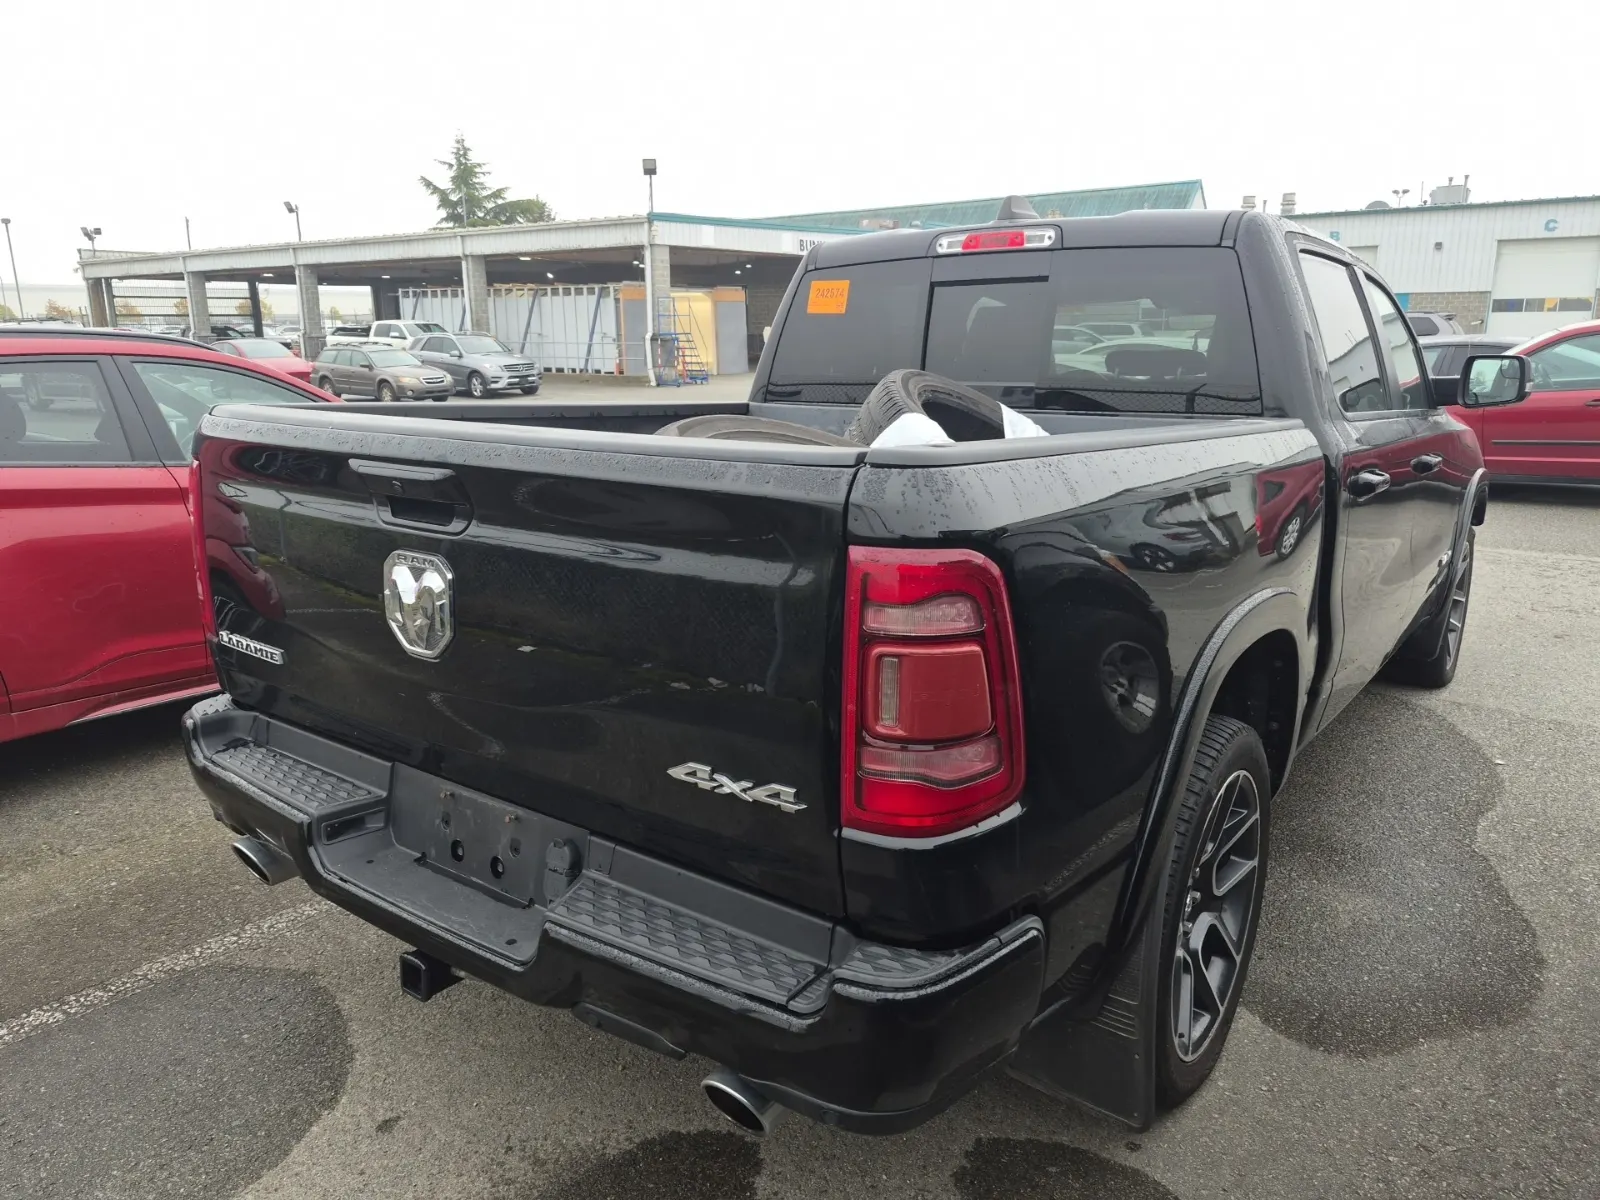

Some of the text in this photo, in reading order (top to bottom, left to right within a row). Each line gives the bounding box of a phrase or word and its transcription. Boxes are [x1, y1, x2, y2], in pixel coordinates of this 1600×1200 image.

[1544, 218, 1558, 232] C
[815, 287, 845, 299] 242574
[395, 553, 435, 569] RAM
[219, 631, 283, 664] LARAMIE
